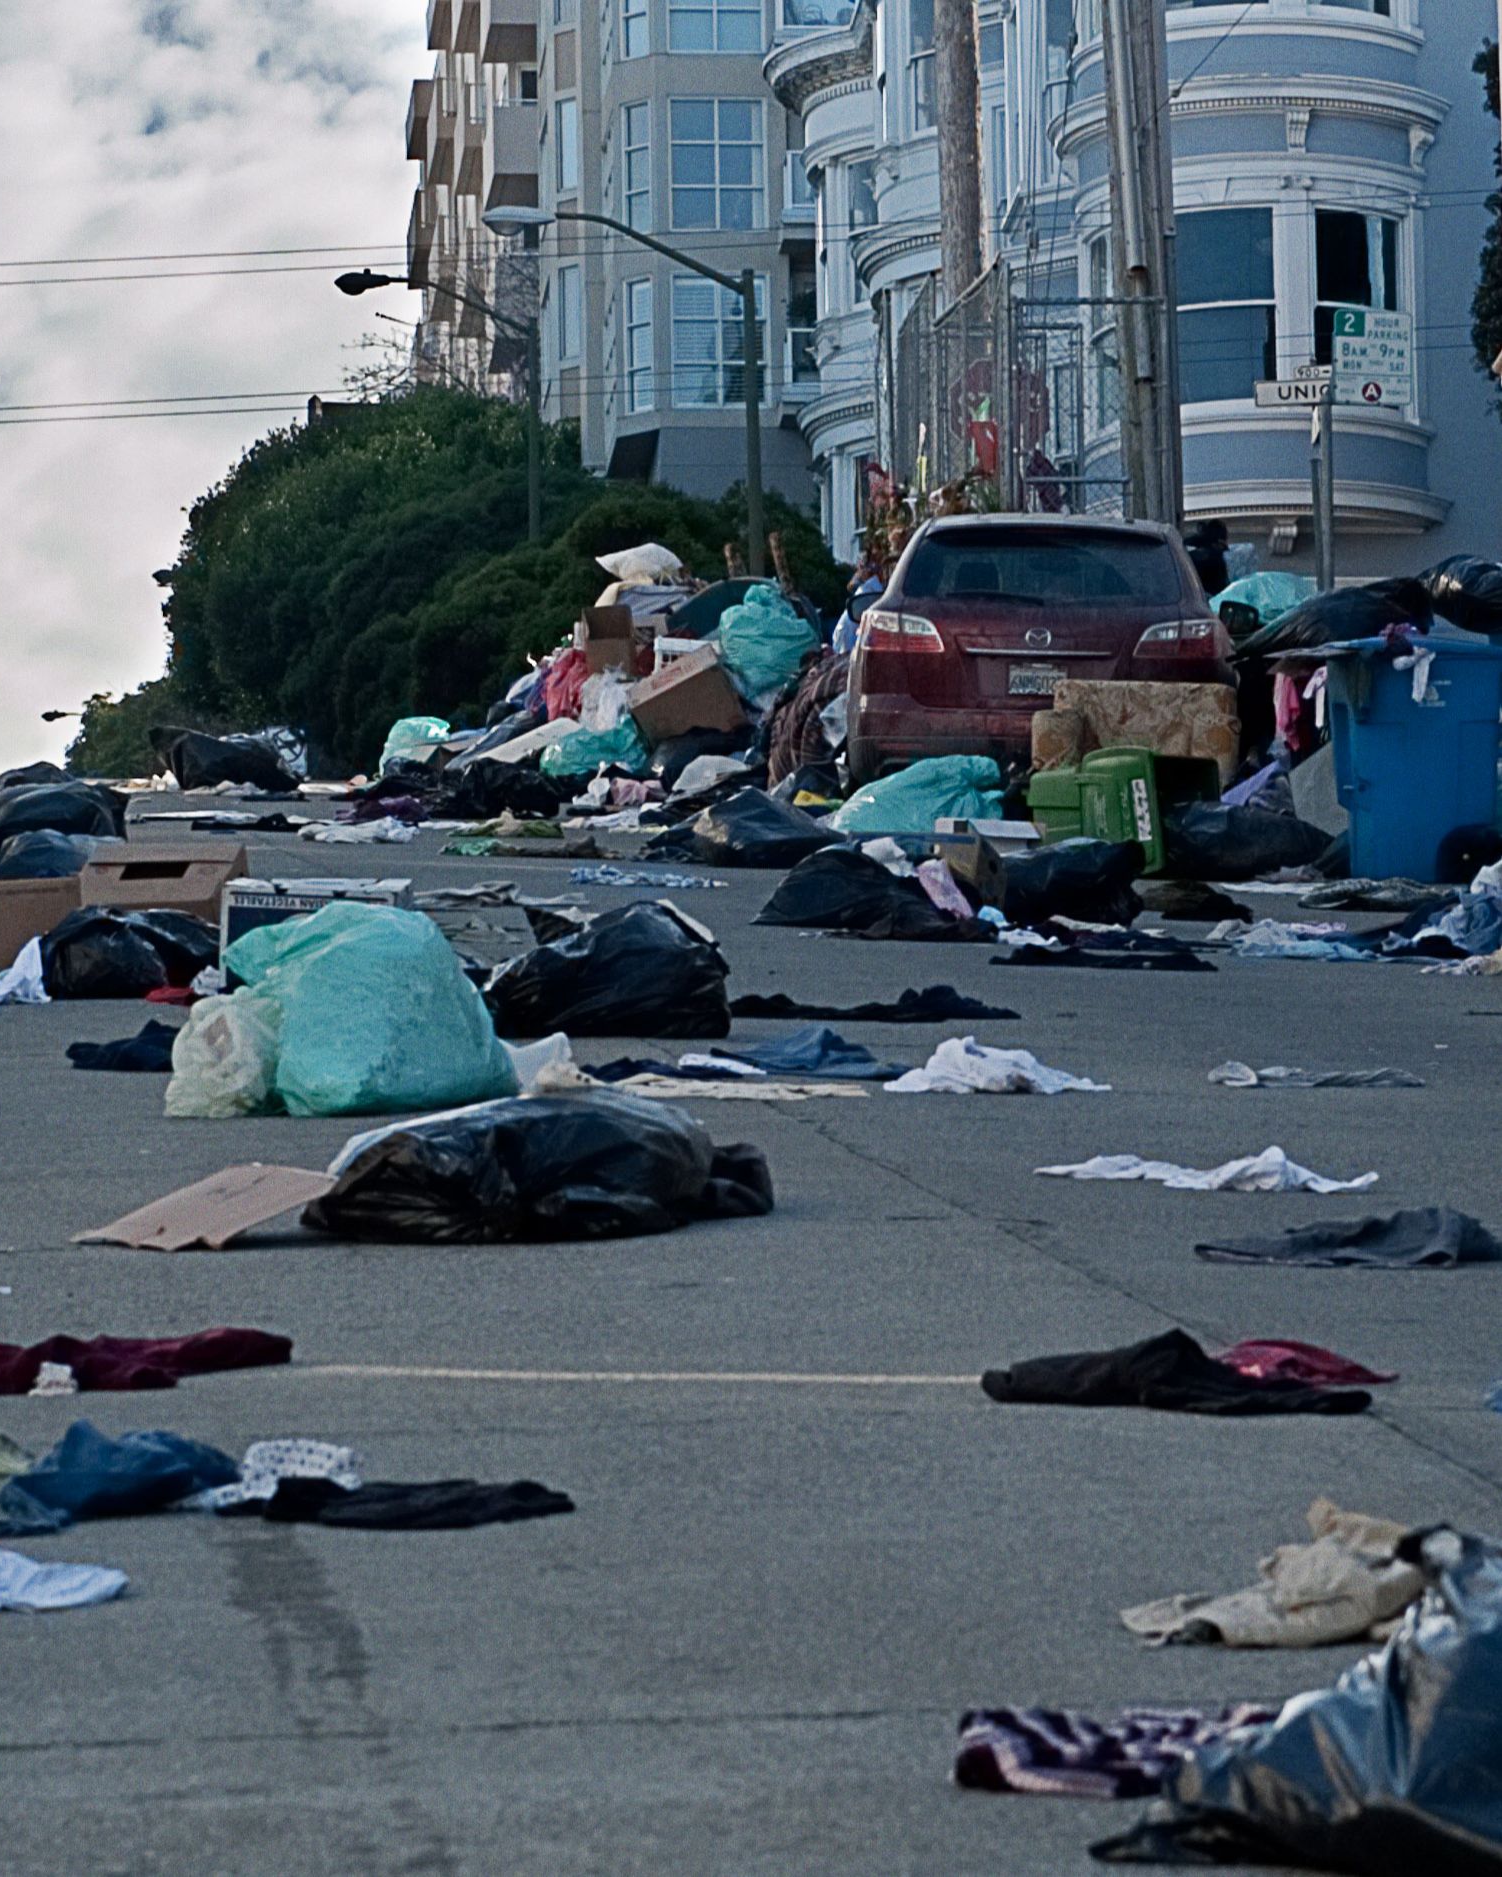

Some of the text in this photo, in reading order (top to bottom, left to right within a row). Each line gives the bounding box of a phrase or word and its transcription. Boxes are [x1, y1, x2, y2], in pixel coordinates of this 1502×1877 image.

[1344, 313, 1355, 333] 2
[1374, 318, 1399, 327] HOUR
[1368, 330, 1409, 342] PARKING
[1343, 360, 1362, 369] MON
[1389, 362, 1405, 372] SAT
[1365, 383, 1379, 397] A
